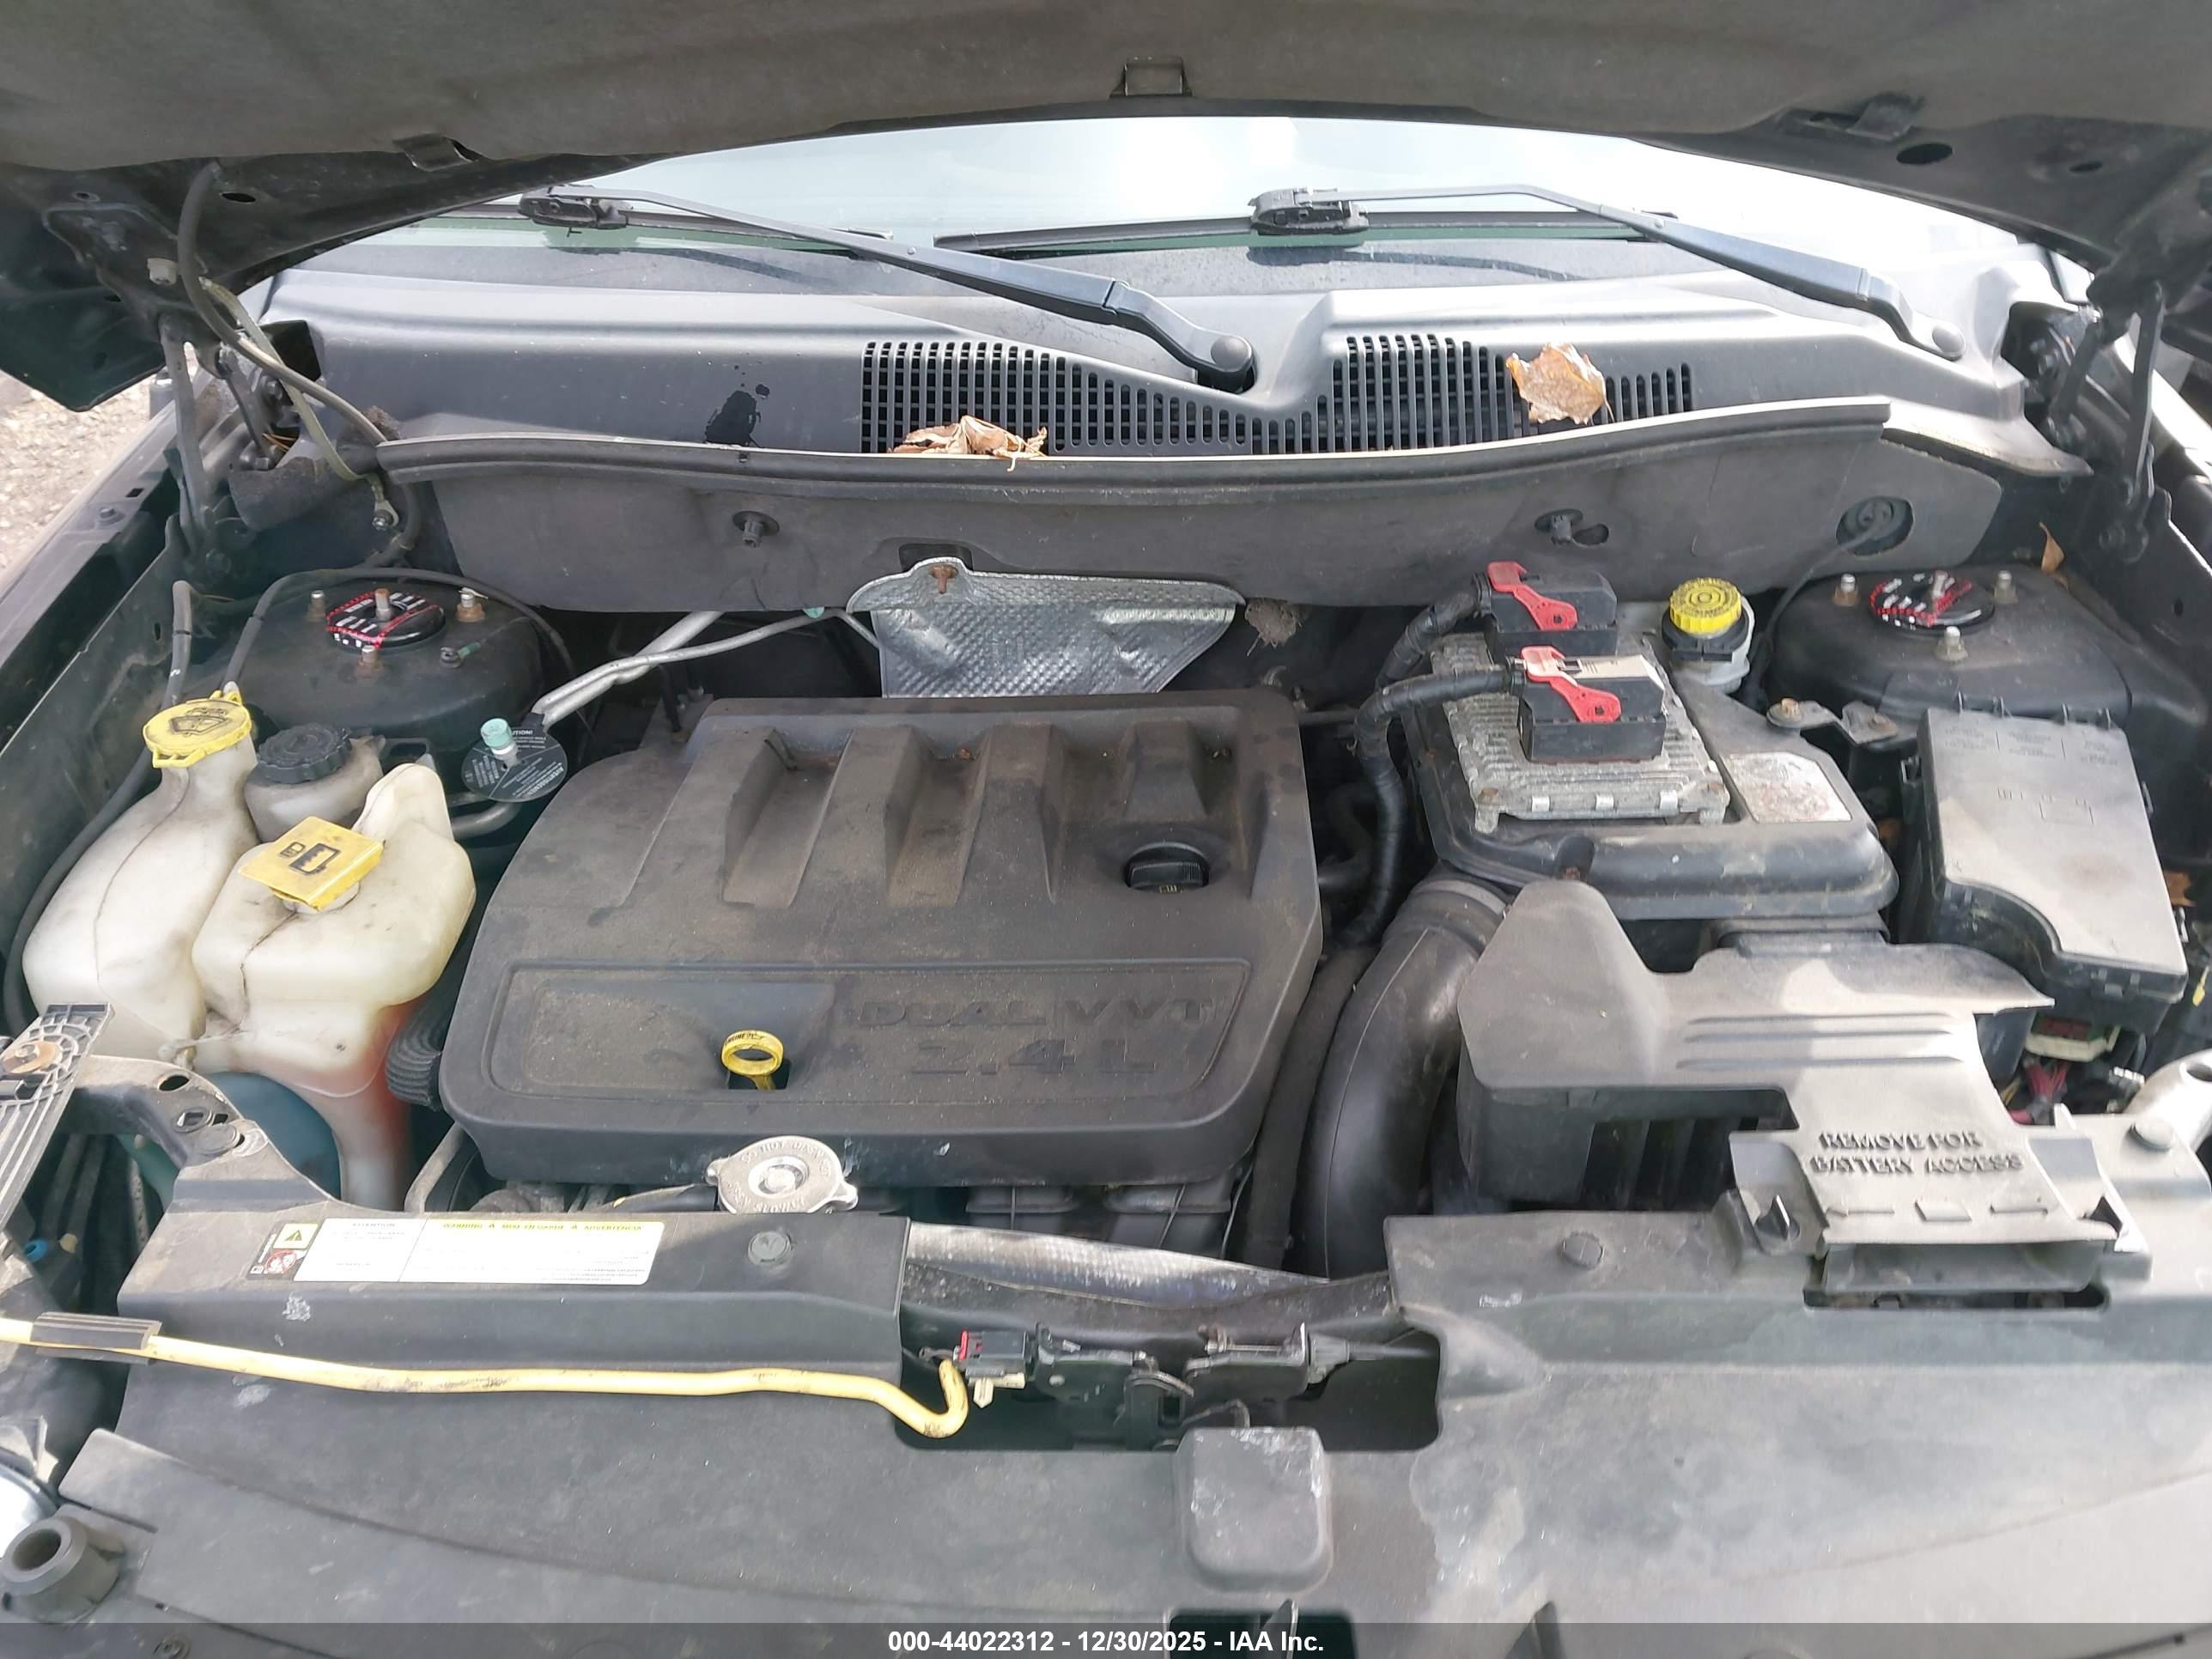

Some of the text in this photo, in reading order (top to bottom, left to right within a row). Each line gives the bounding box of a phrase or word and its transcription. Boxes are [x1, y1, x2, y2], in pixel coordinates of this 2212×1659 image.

[859, 999, 1212, 1026] DUAL VVT
[759, 1140, 785, 1155] NOT
[1819, 1130, 1984, 1150] REMOVE FOR
[1809, 1153, 2026, 1175] BATTERY ACCESS
